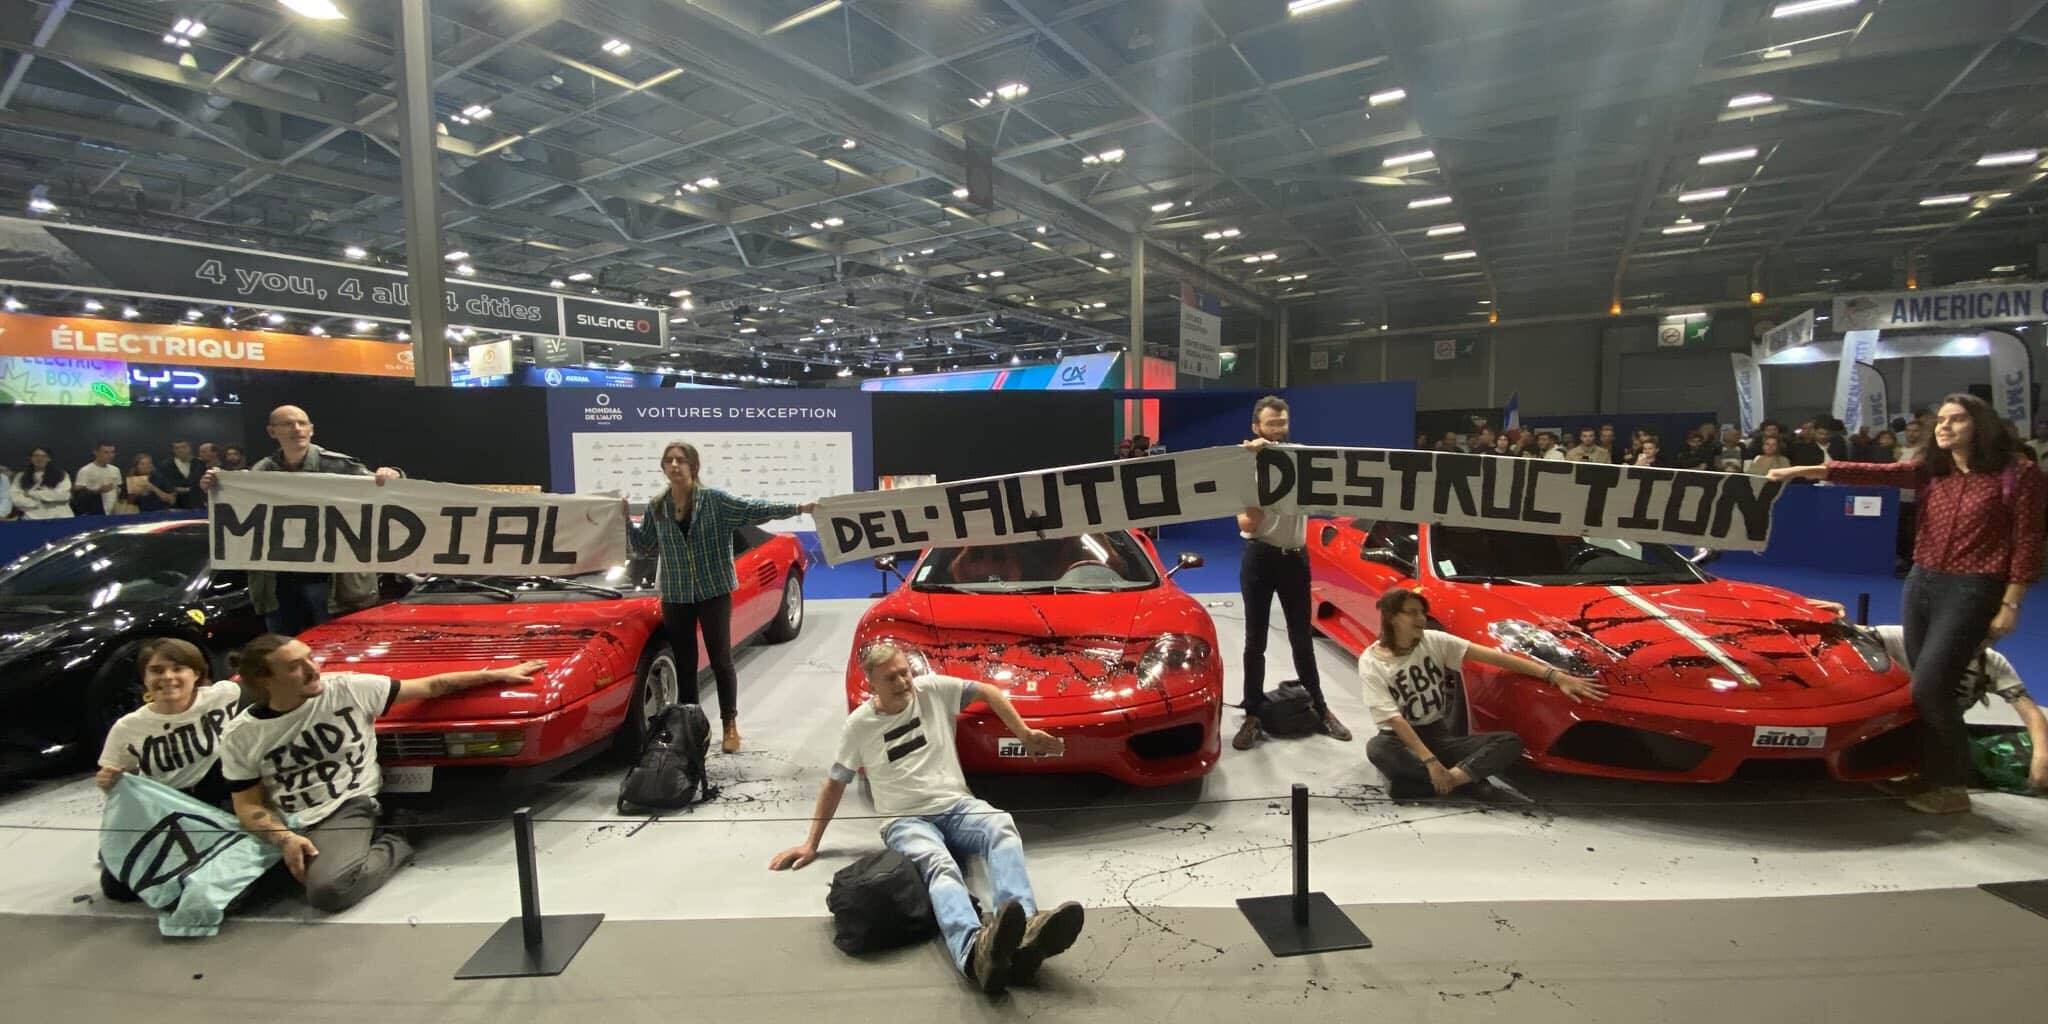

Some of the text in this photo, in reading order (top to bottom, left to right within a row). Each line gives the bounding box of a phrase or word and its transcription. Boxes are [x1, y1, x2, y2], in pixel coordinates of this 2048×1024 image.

[195, 259, 226, 284] 4
[235, 268, 327, 300] you,
[337, 278, 363, 300] 4
[466, 294, 542, 321] cities
[1891, 290, 2032, 324] AMERICAN
[51, 324, 266, 361] ÉLECTRIQUE
[46, 370, 82, 388] BOX
[127, 367, 207, 389] YD
[637, 407, 836, 418] VOITURES D'EXCEPTION
[1256, 448, 1783, 542] DESTRUCTION
[213, 503, 577, 565] MONDIAL
